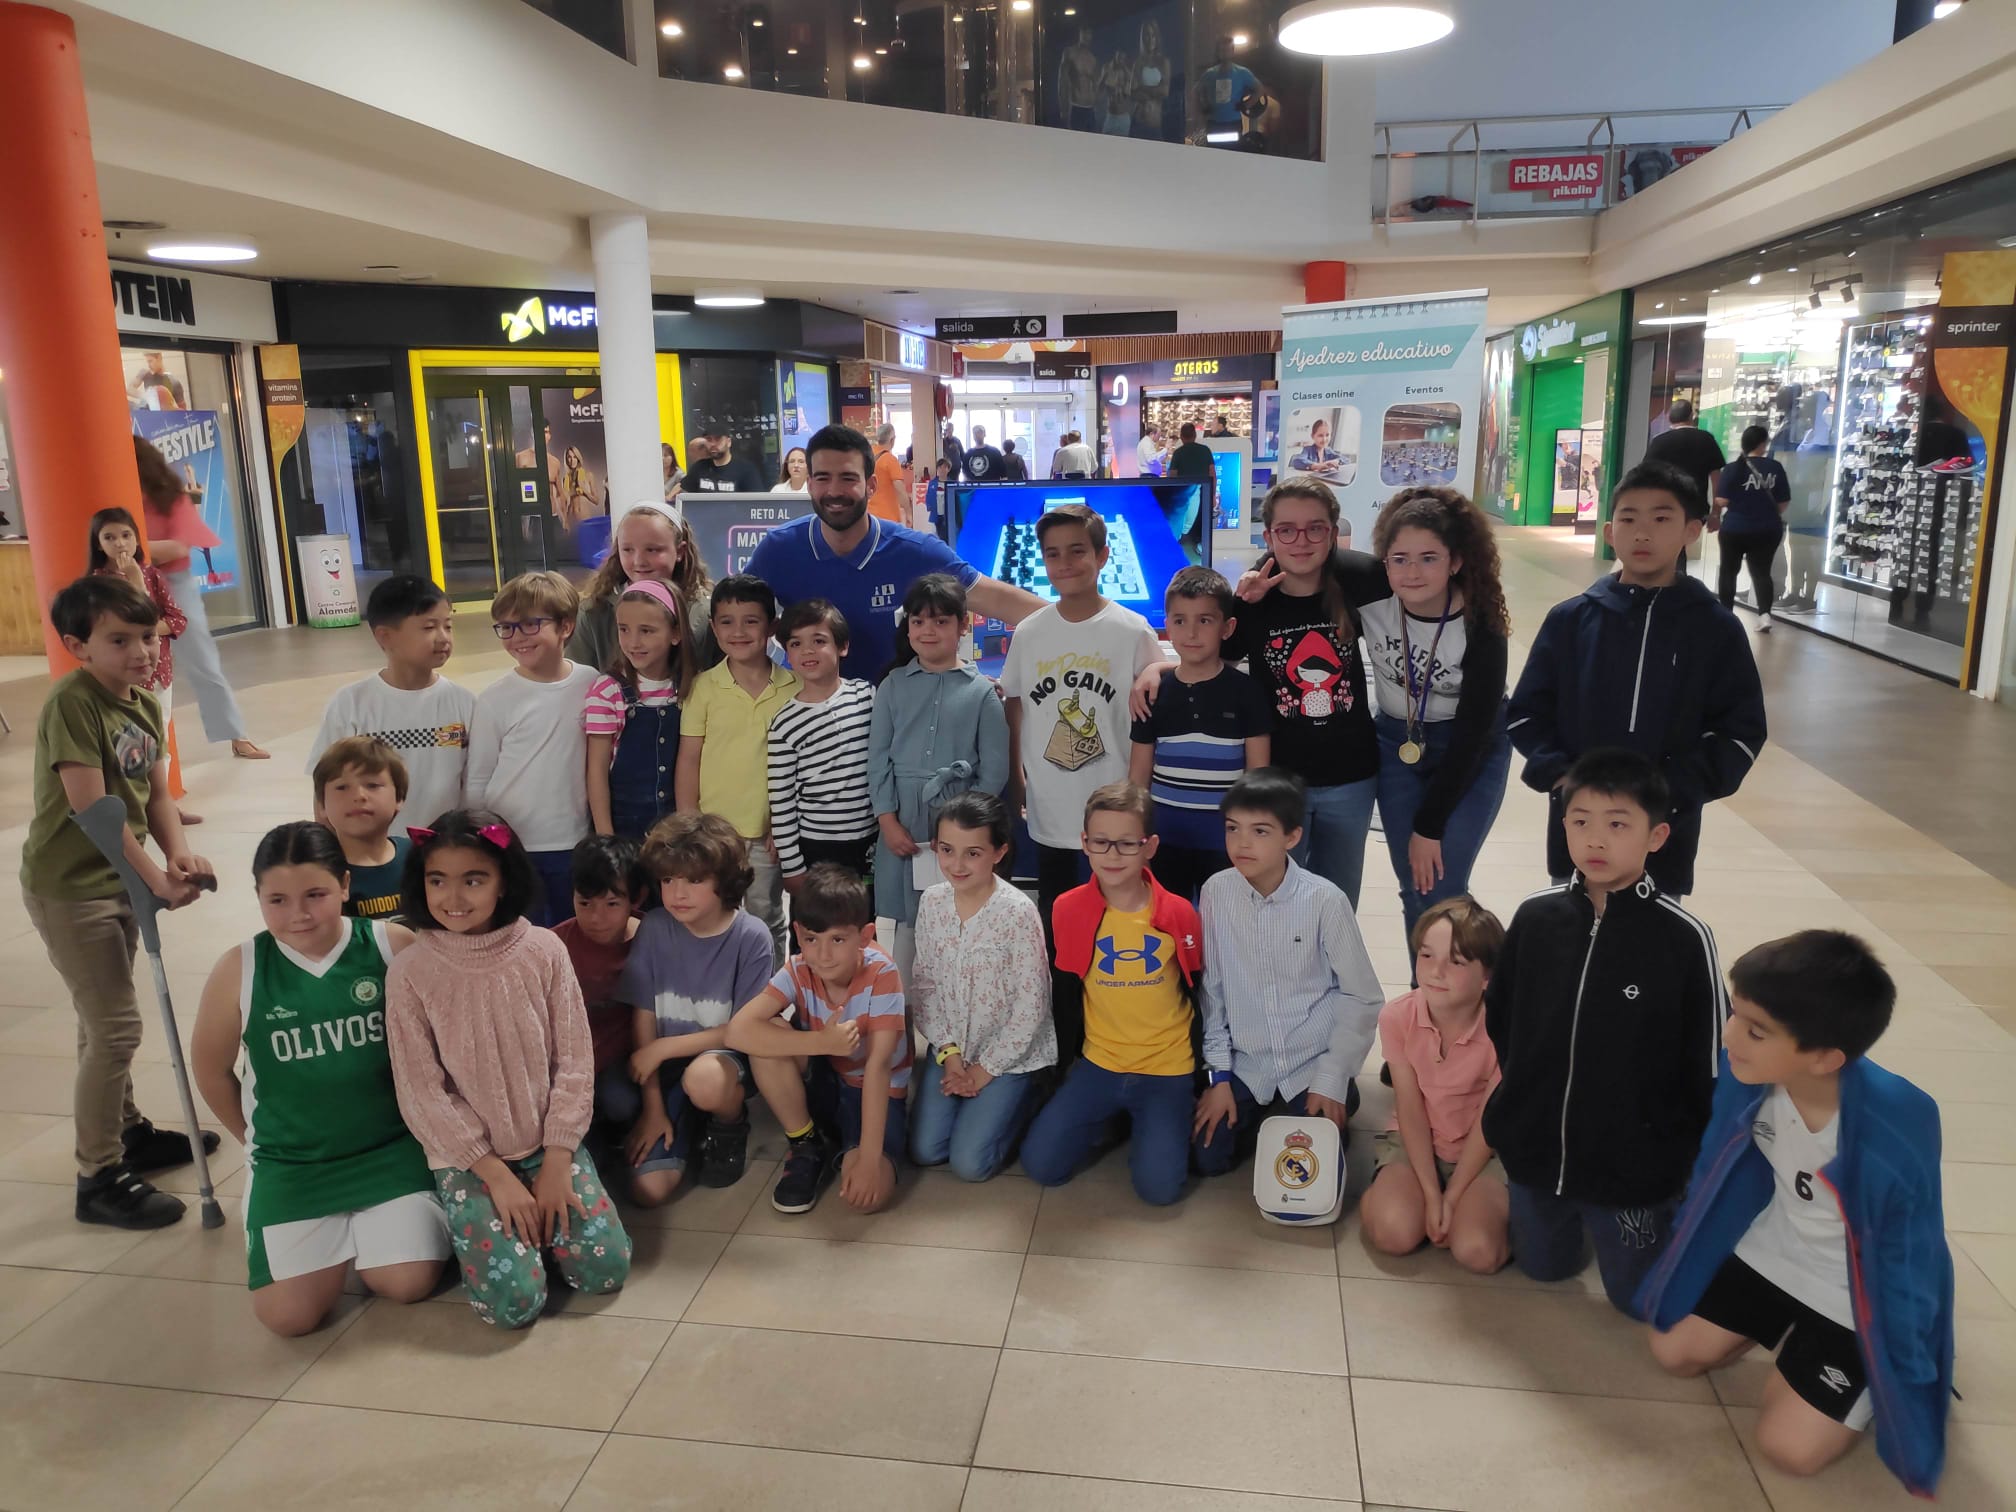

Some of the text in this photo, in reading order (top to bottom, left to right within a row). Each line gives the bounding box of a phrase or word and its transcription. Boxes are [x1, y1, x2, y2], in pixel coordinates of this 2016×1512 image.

[1514, 162, 1598, 184] REBAJAS
[1553, 186, 1592, 198] pikolin
[110, 270, 196, 326] TEIN
[942, 322, 974, 333] salida
[1947, 321, 2001, 334] sprinter
[1286, 340, 1453, 372] Ajedrez educativo
[268, 383, 298, 392] vitamins
[1405, 386, 1444, 396] Eventos
[271, 394, 297, 402] protein
[1292, 389, 1355, 401] Clases online
[750, 508, 790, 519] RETO AL
[1029, 671, 1116, 706] NO GAIN
[1096, 978, 1126, 988] UNDER
[271, 1011, 384, 1062] OLIVOS
[1795, 1171, 1813, 1201] 6
